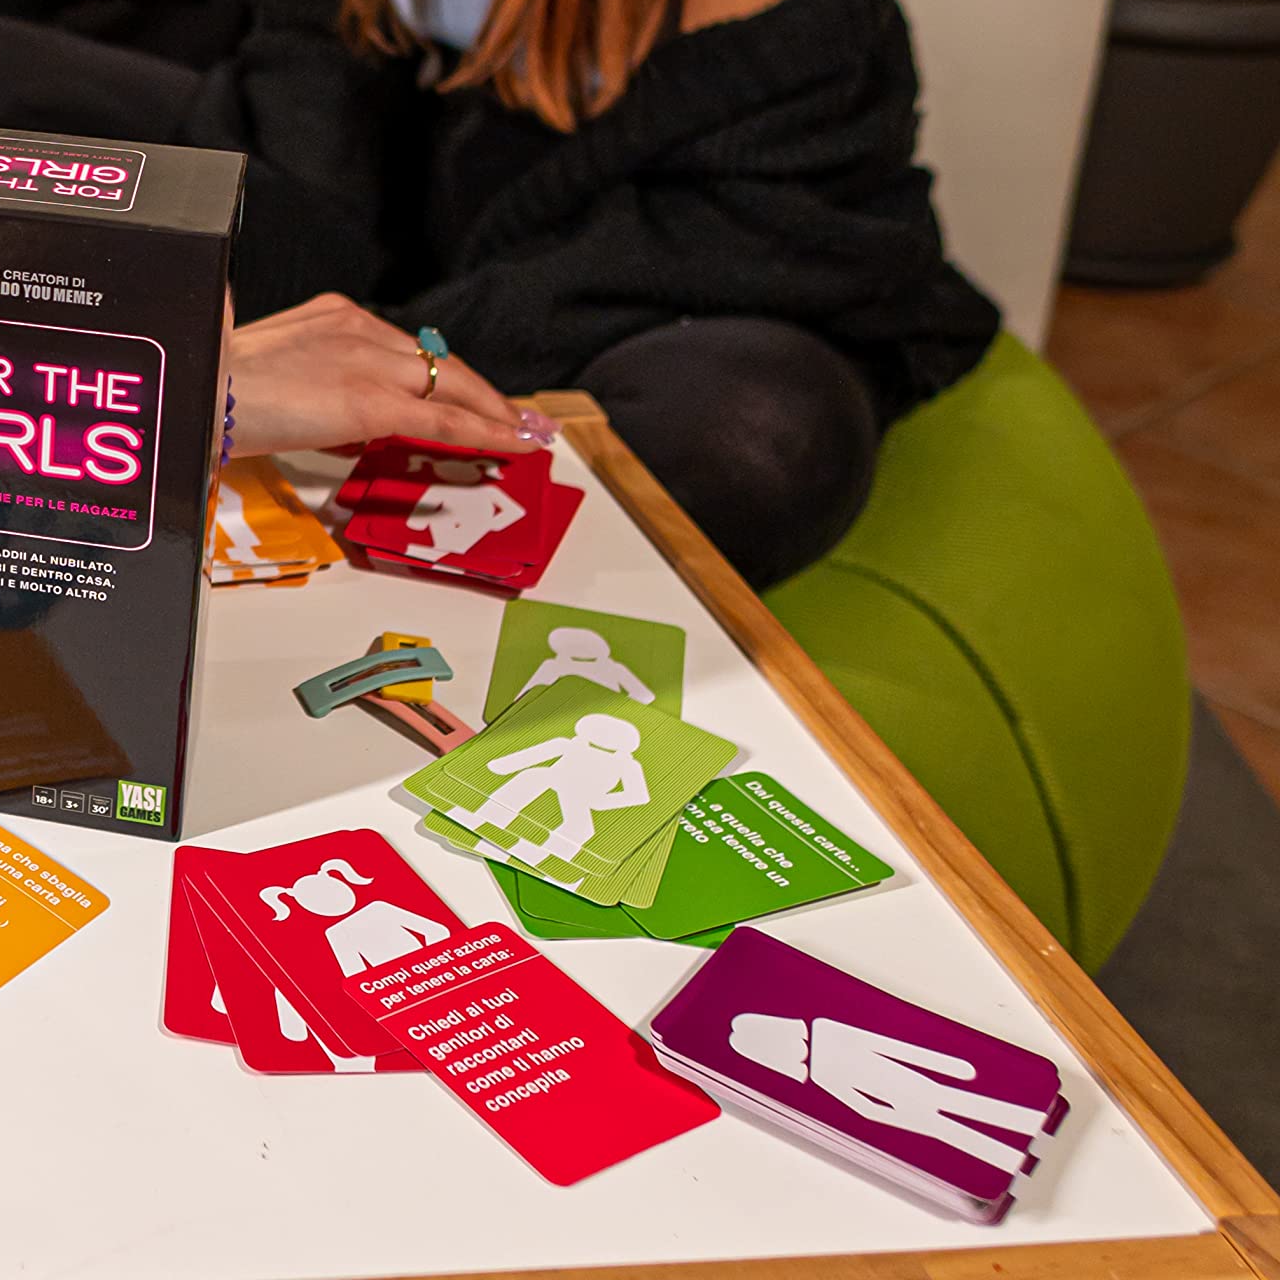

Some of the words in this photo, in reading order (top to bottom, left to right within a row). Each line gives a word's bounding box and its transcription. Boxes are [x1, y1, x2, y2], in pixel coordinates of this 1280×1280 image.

[52, 181, 123, 201] FOR
[0, 282, 20, 297] DO
[23, 284, 51, 300] YOU
[53, 287, 103, 306] MEME?
[3, 270, 69, 287] CREATORI
[72, 277, 85, 288] DI
[33, 363, 143, 414] THE
[16, 495, 44, 508] PER
[48, 499, 65, 511] LE
[70, 502, 137, 520] RAGAZZE
[10, 564, 18, 574] E
[21, 566, 73, 582] DENTRO
[76, 574, 116, 589] CASA,
[30, 552, 47, 564] AL
[50, 555, 117, 575] NUBILATO,
[8, 579, 16, 588] E
[19, 581, 63, 595] MOLTO
[65, 587, 107, 601] ALTRO
[35, 794, 53, 805] 18+
[65, 800, 79, 809] 3+
[120, 806, 161, 823] GAMES
[121, 783, 161, 812] YAS!
[709, 804, 723, 812] a
[721, 813, 765, 846] quella
[763, 848, 793, 868] che
[745, 781, 773, 799] Dai
[768, 800, 815, 835] questa
[814, 836, 859, 871] carta...
[703, 820, 723, 834] sa
[722, 834, 768, 870] tenere
[766, 871, 789, 887] un
[13, 853, 39, 871] che
[40, 871, 91, 908] sbaglia
[24, 879, 60, 905] carta
[360, 968, 411, 994] Compi
[411, 934, 501, 974] quest'azione
[380, 991, 406, 1009] per
[406, 972, 455, 995] tenere
[452, 966, 472, 976] la
[472, 949, 514, 969] carta:
[408, 1010, 466, 1040] Chiedi
[466, 1002, 484, 1017] ai
[481, 988, 519, 1009] tuoi
[428, 1022, 495, 1061] genitori
[495, 1014, 514, 1029] di
[446, 1028, 539, 1076] raccontarti
[466, 1066, 515, 1093] come
[513, 1057, 531, 1071] ti
[526, 1037, 584, 1065] hanno
[486, 1069, 571, 1111] concepita
